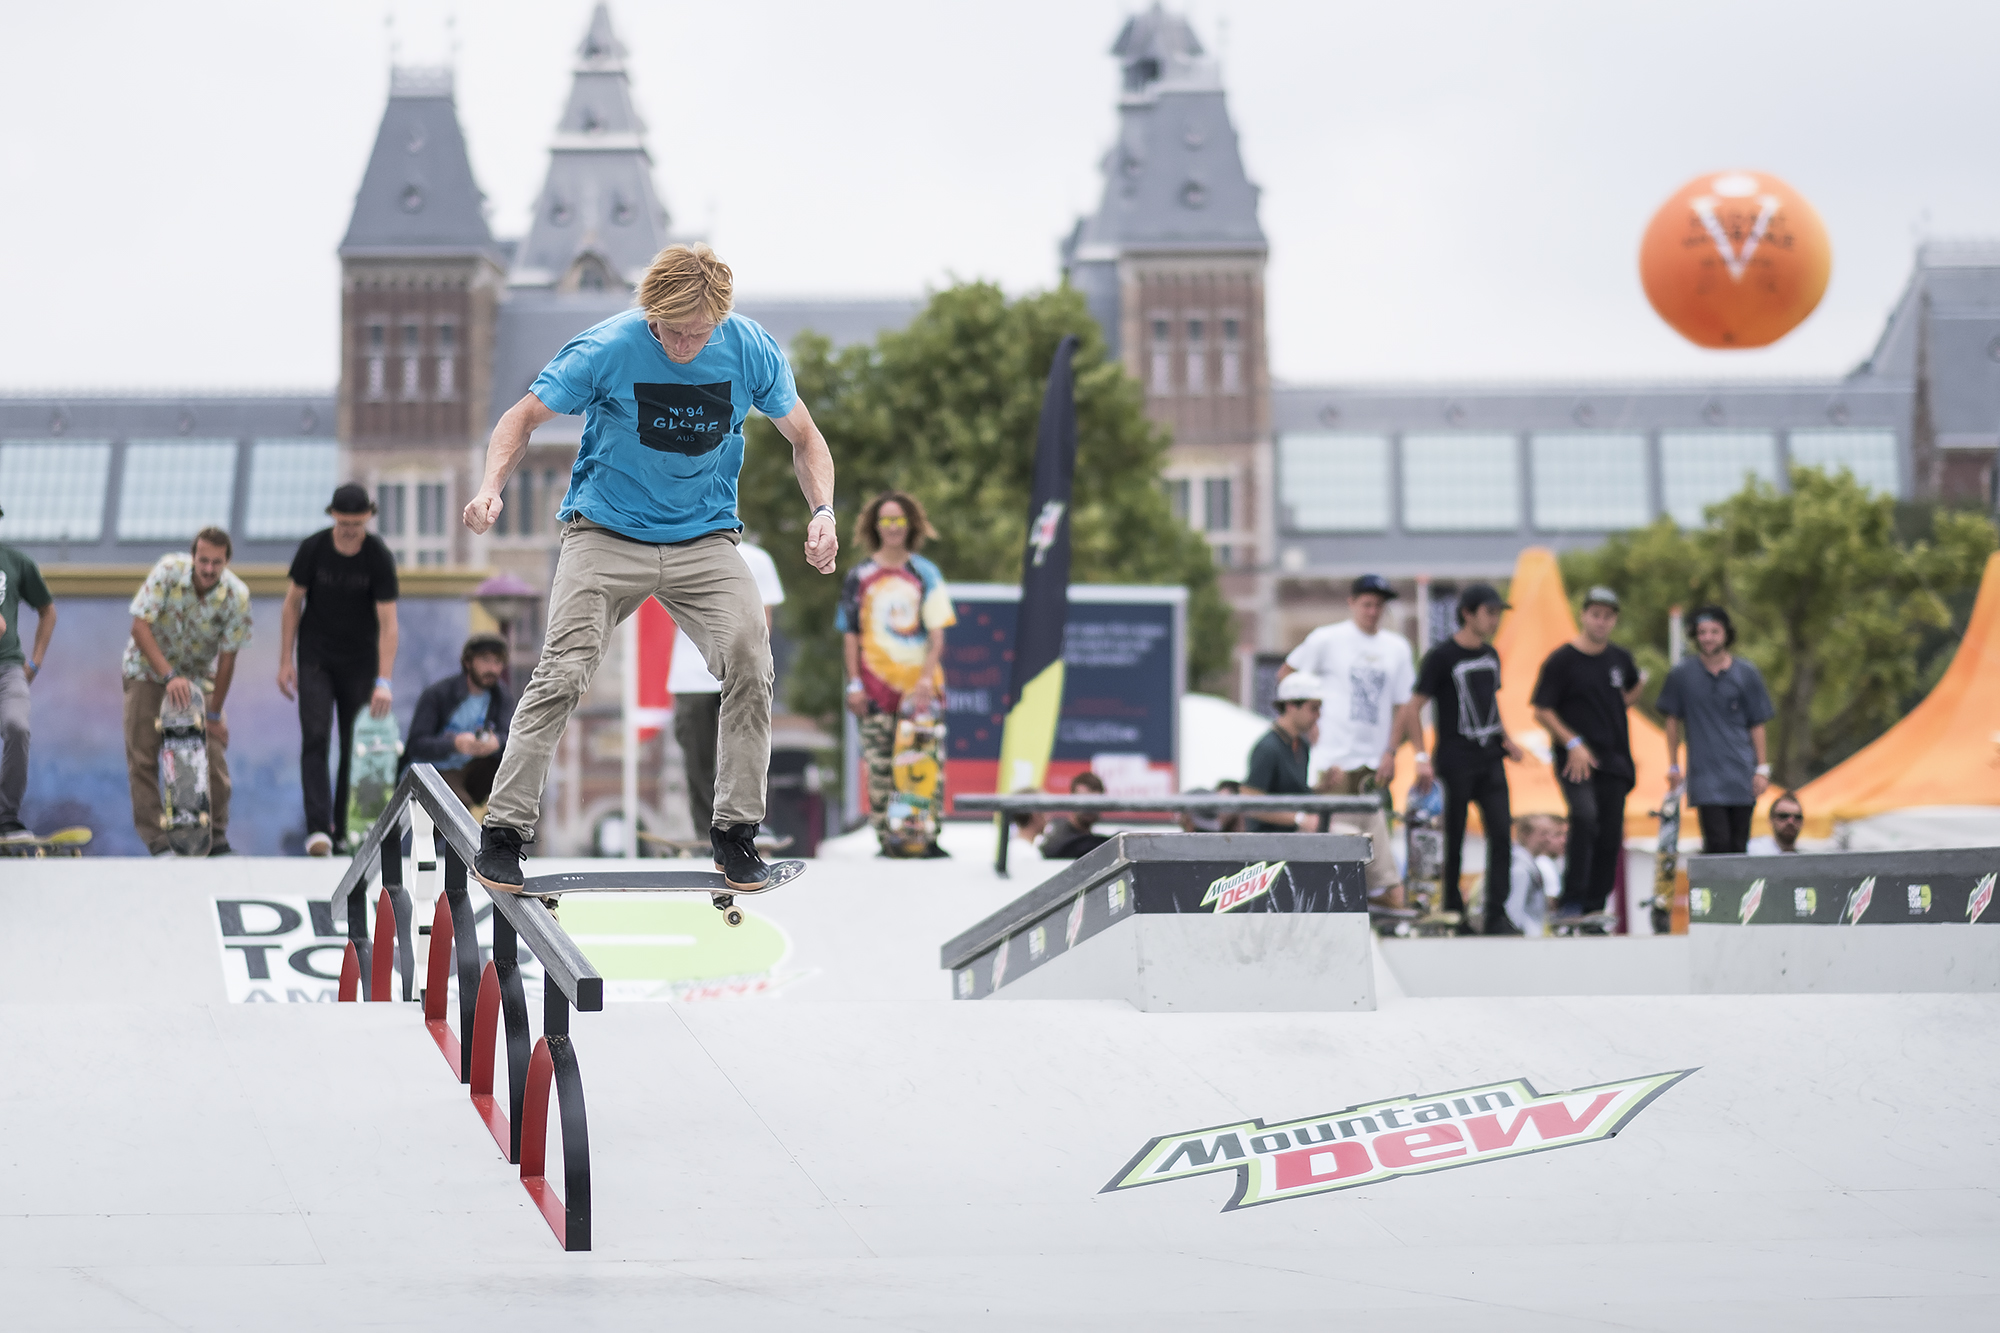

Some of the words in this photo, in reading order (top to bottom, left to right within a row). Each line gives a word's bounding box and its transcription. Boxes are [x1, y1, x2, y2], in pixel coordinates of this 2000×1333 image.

[675, 434, 695, 442] AUS
[1207, 865, 1263, 900] Mountain
[1153, 1089, 1515, 1174] Mountain
